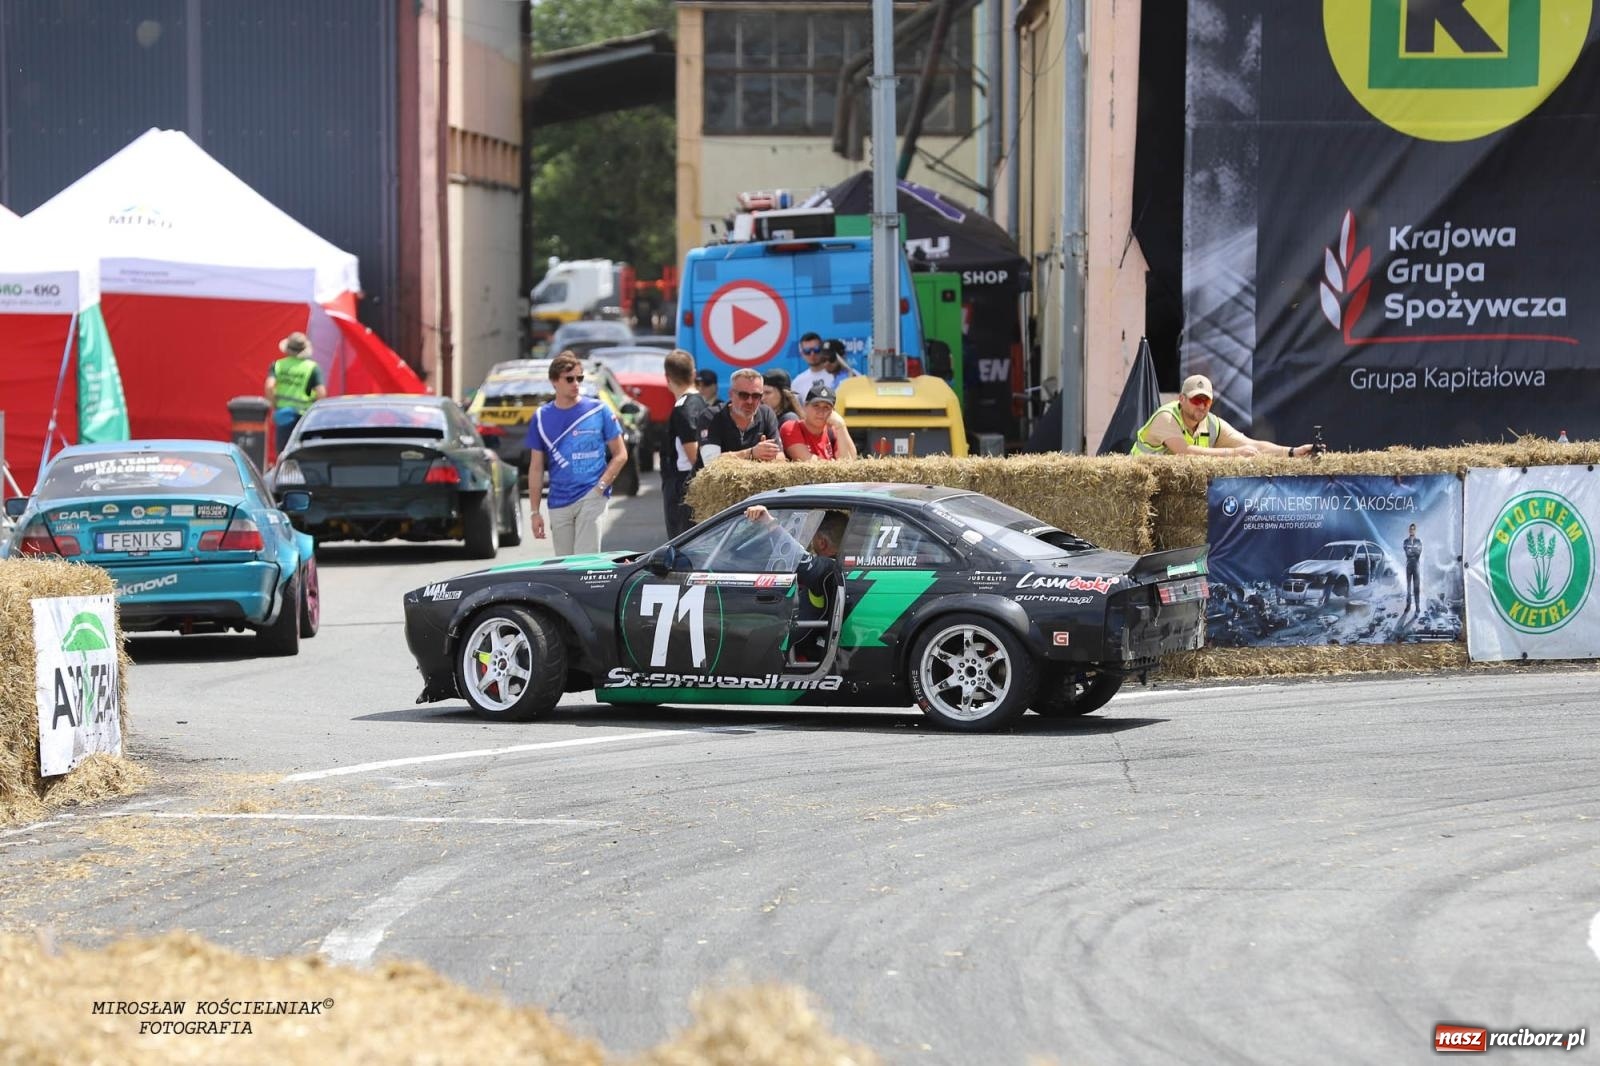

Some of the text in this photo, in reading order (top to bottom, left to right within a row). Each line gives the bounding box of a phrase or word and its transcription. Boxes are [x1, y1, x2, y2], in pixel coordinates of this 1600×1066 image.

[1389, 222, 1516, 256] Krajowa
[962, 270, 1008, 284] SHOP
[1387, 258, 1485, 289] Grupa
[1384, 290, 1567, 326] Spożywcza
[1350, 364, 1546, 394] Grupa Kapitałowa
[1244, 495, 1340, 513] PARTNERSTWO
[1343, 496, 1352, 510] Z
[1495, 500, 1583, 545] BIOCHEM
[111, 532, 173, 548] FENIKS
[876, 525, 902, 549] 71
[856, 556, 917, 566] M.JARKIEWICZ
[639, 584, 707, 668] 71
[1509, 599, 1570, 627] KIETRZ
[1053, 632, 1068, 645] G
